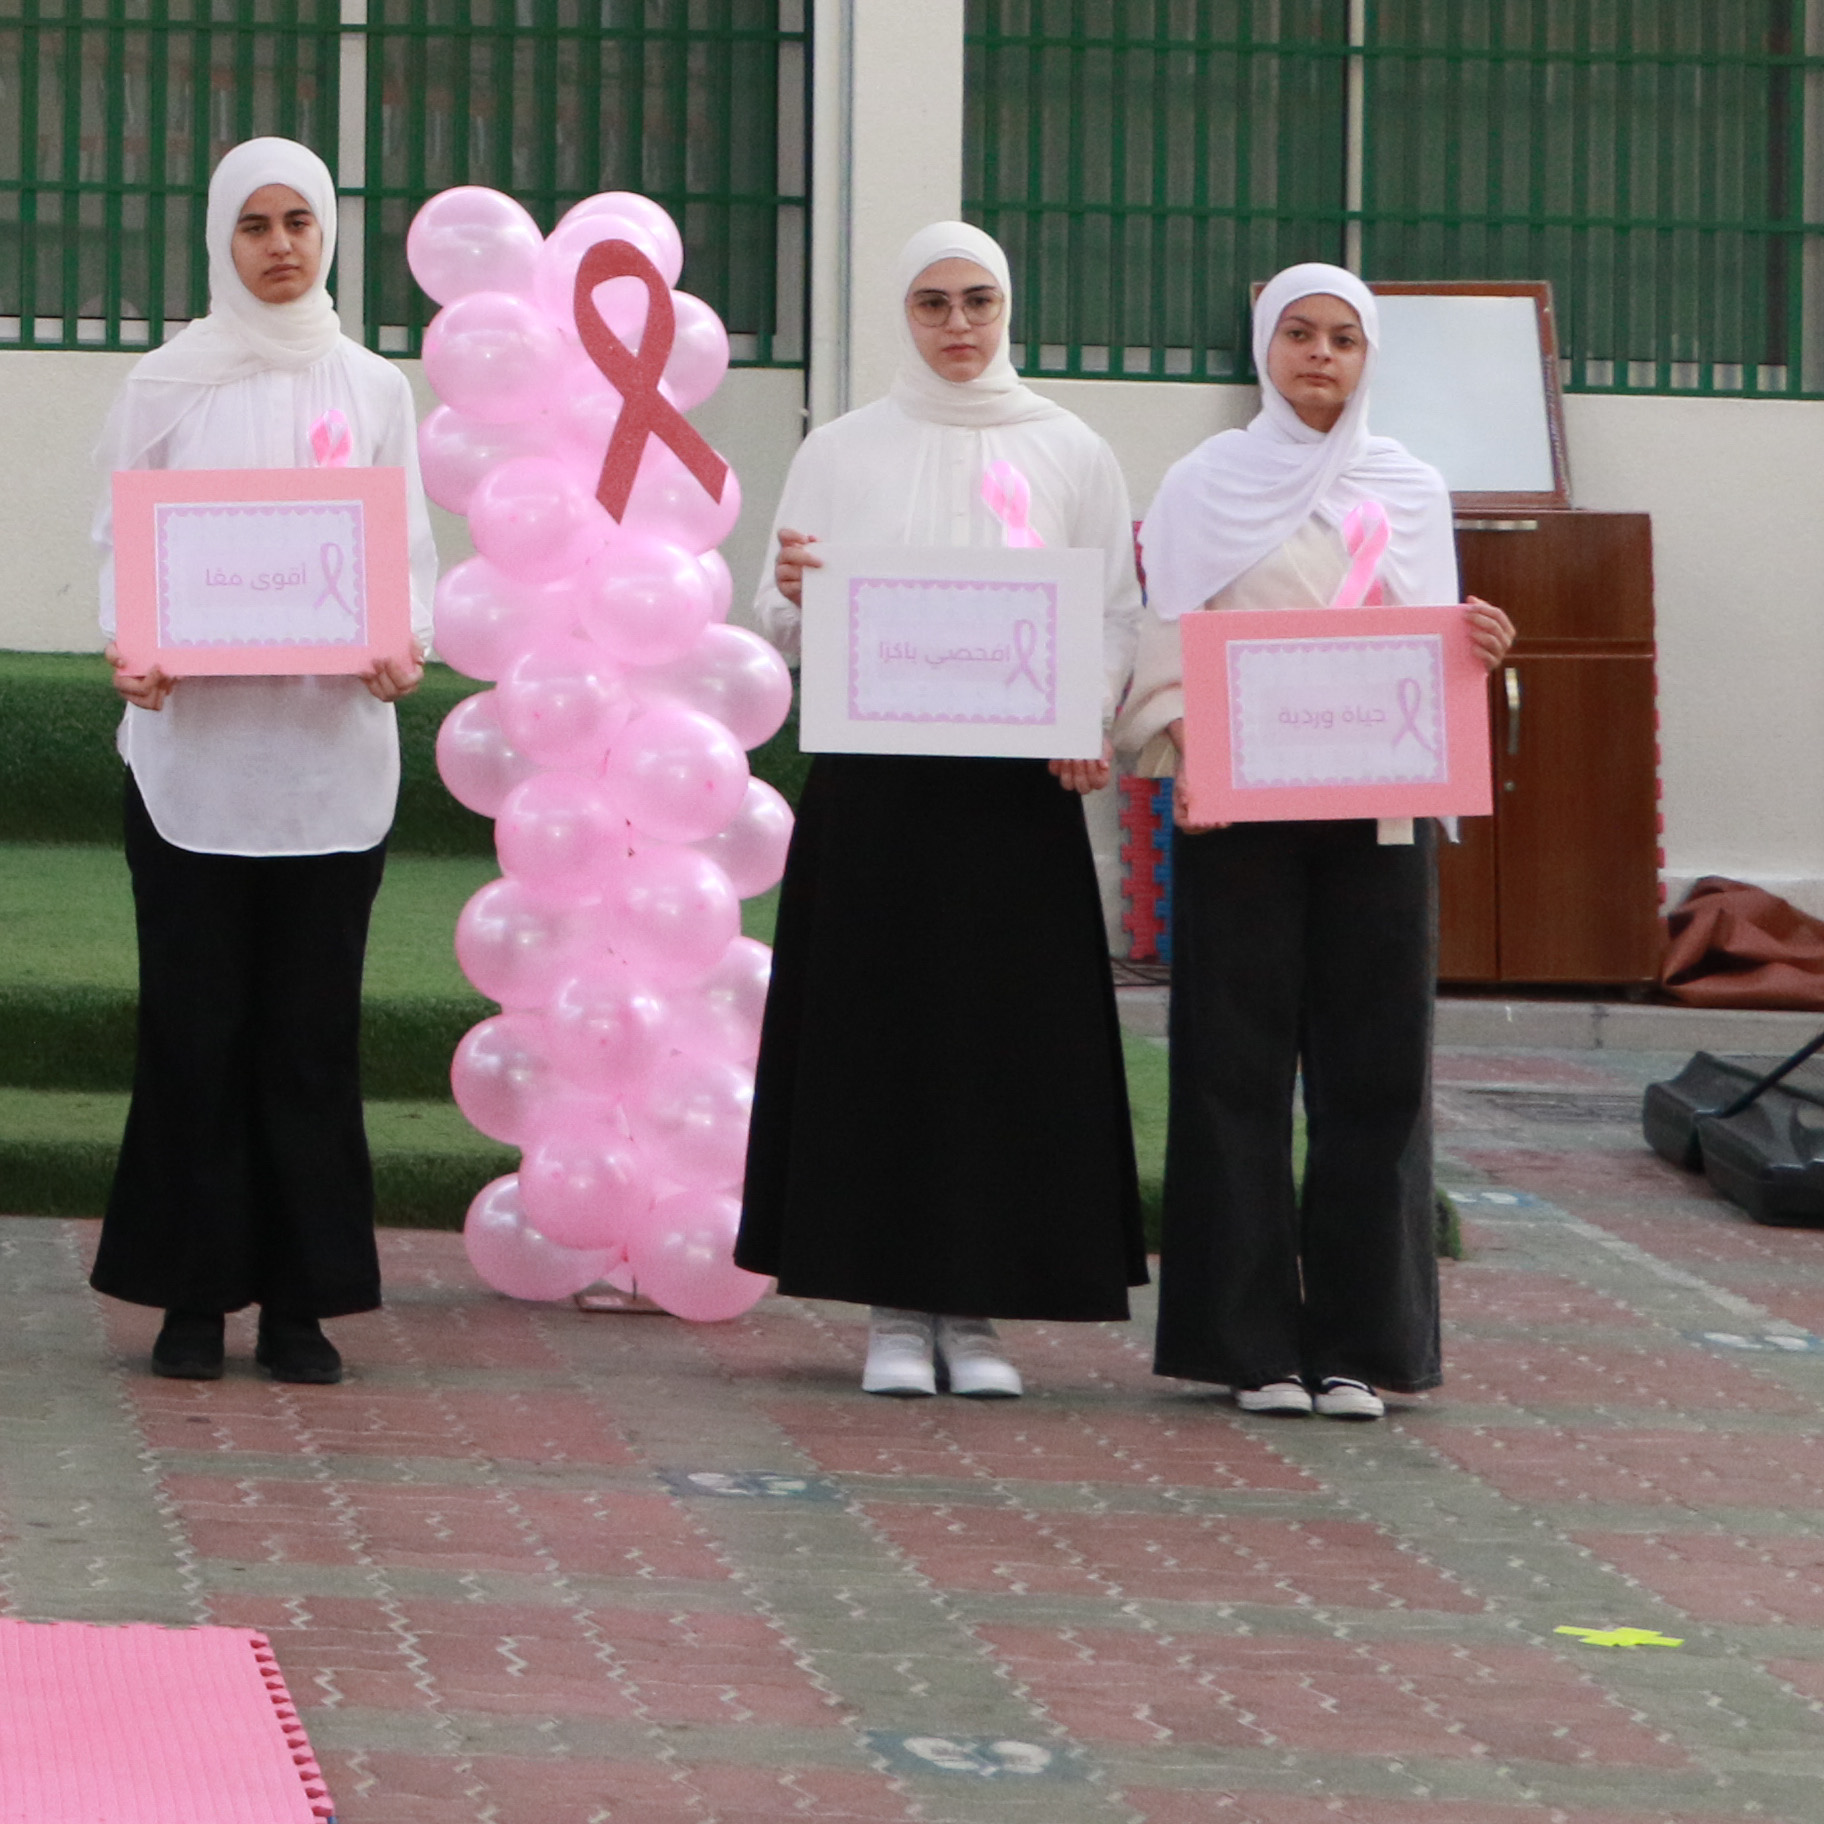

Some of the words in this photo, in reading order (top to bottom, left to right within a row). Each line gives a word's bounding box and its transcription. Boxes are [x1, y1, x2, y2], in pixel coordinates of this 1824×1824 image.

[248, 562, 309, 592] أقوى
[923, 642, 1012, 669] افحصي
[1339, 705, 1388, 729] حياة
